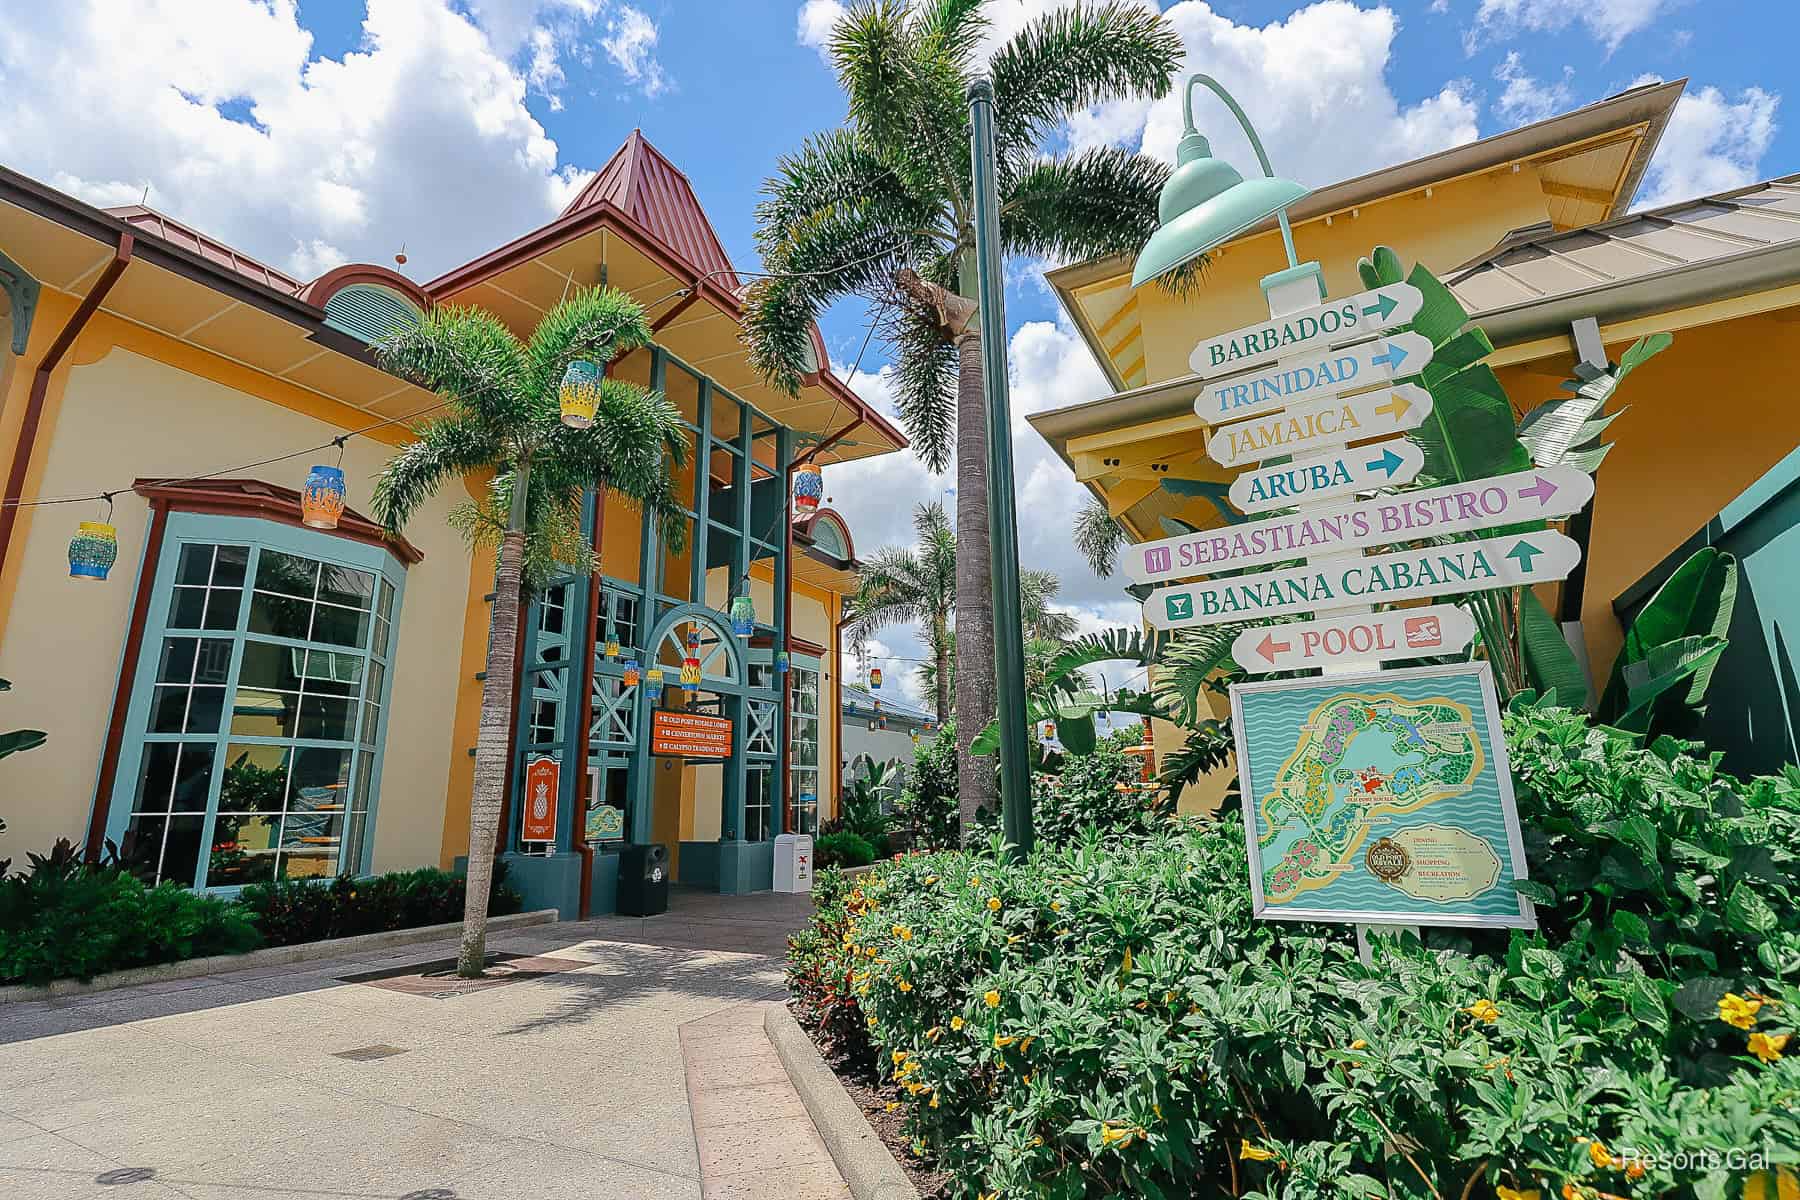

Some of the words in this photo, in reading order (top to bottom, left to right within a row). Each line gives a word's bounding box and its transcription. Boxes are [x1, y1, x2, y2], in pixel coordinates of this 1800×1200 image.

[1208, 305, 1358, 367] BARBADOS
[1215, 356, 1359, 412] TRINIDAD
[1228, 405, 1361, 462] JAMAICA
[1248, 459, 1354, 503] ARUBA
[1179, 511, 1370, 568] SEBASTIAN'S
[1377, 487, 1508, 532] BISTRO
[1200, 573, 1334, 616] BANANA
[1341, 550, 1496, 597] CABANA
[1302, 623, 1395, 658] POOL
